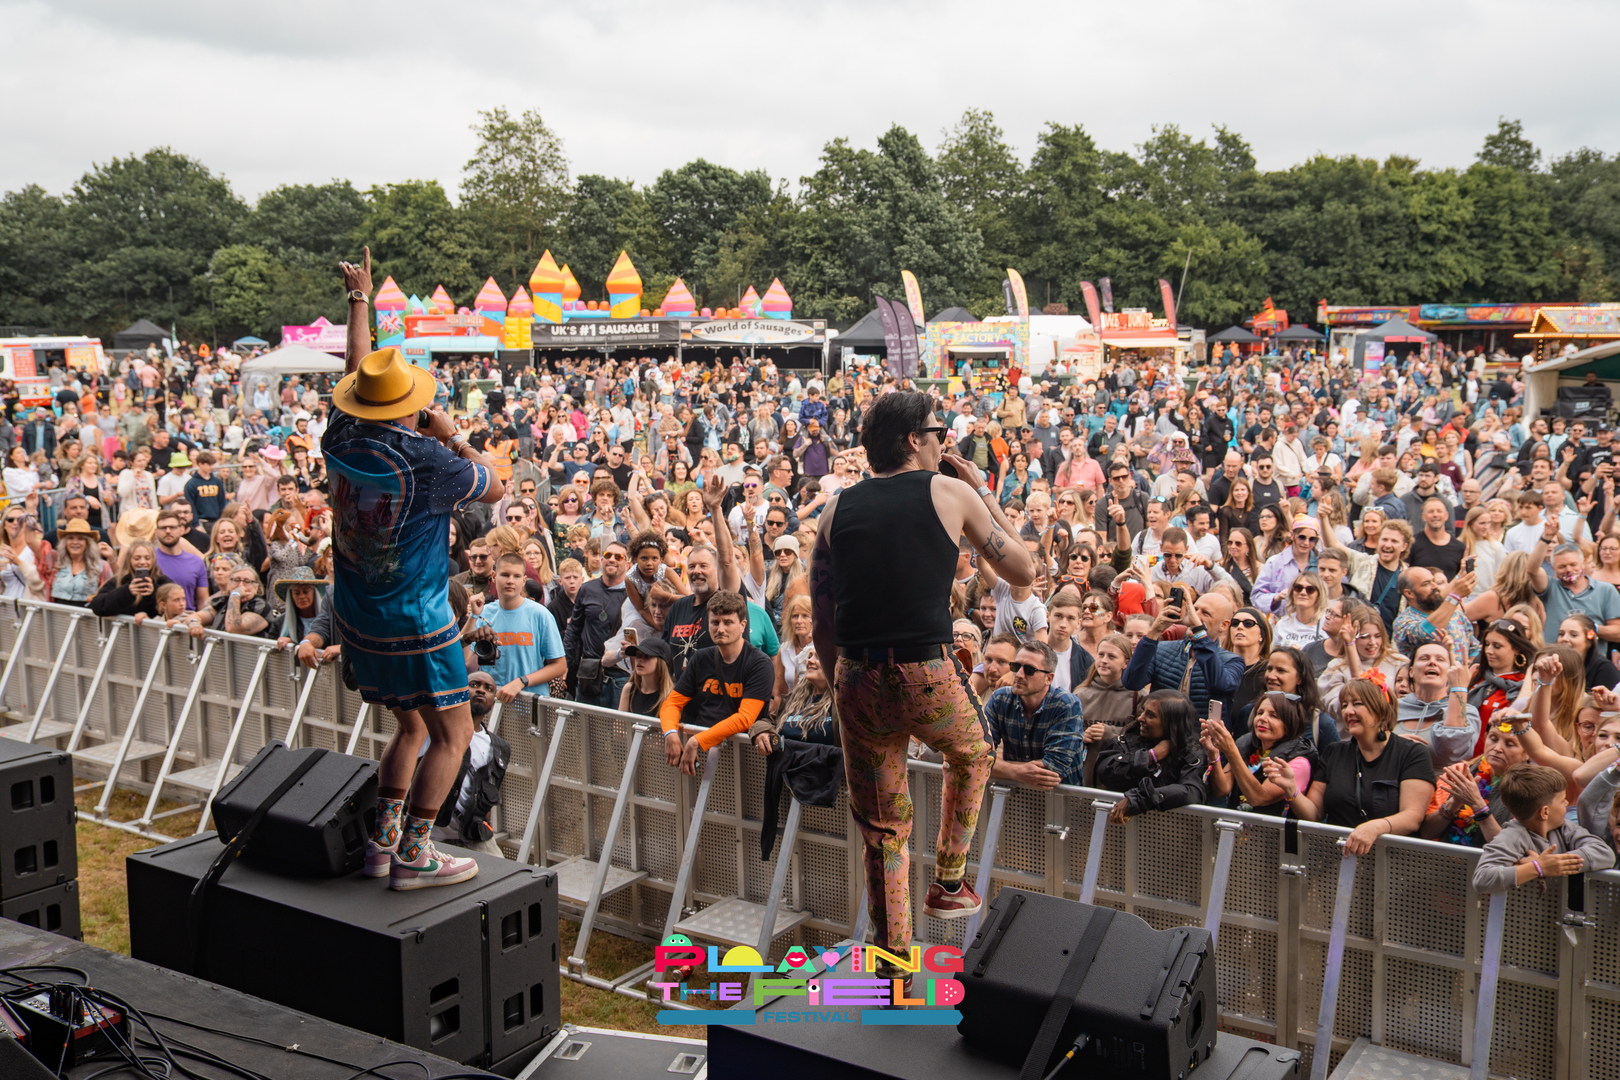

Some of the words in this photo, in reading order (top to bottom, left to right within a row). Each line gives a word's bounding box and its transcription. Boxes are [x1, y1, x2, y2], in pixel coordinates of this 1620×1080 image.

[467, 316, 482, 324] PIZZA
[1104, 313, 1119, 328] WE
[1128, 312, 1153, 328] DONUTS
[579, 323, 597, 337] #1
[598, 323, 650, 335] SAUSAGE
[704, 322, 738, 334] World
[741, 321, 752, 330] of
[754, 322, 802, 336] Sausages
[962, 323, 994, 333] SLUSH
[953, 333, 1001, 343] FACTORY
[496, 631, 534, 646] EEDER
